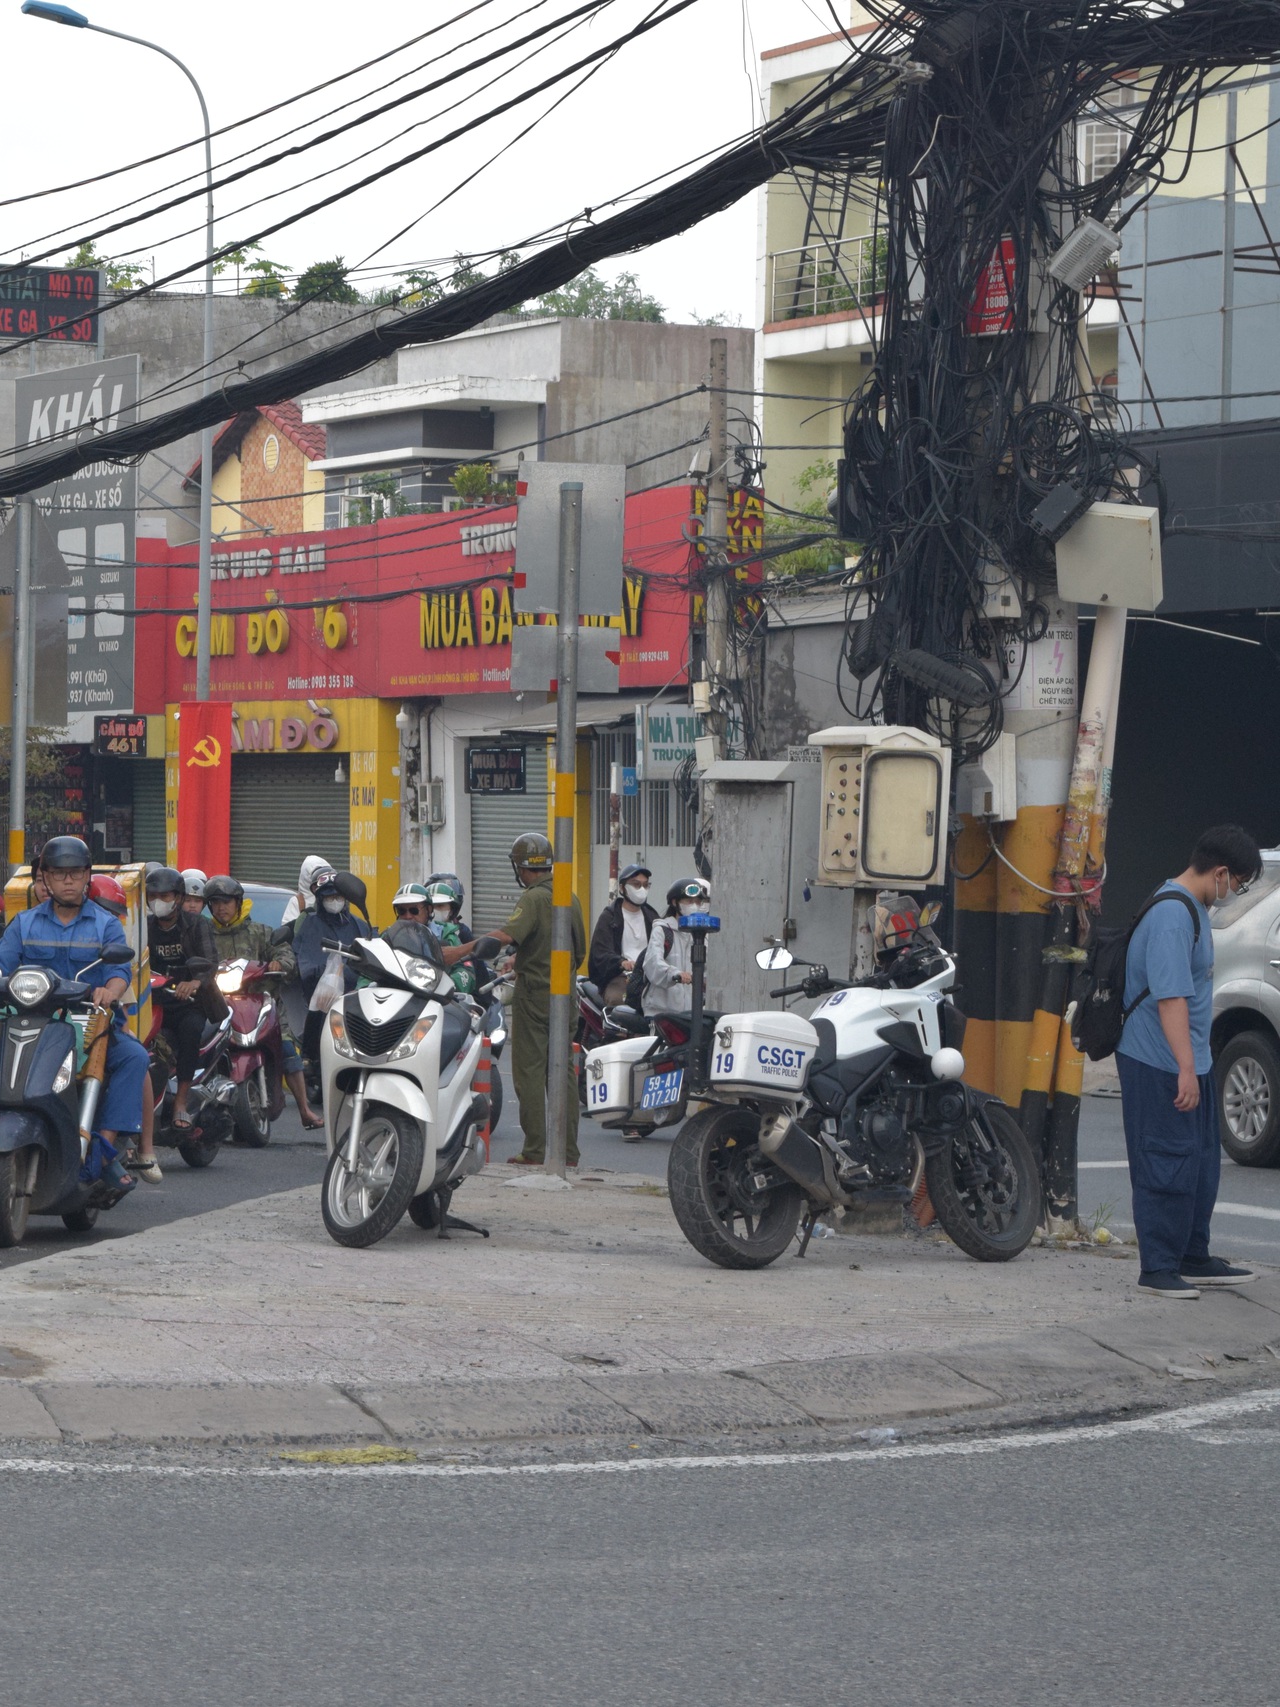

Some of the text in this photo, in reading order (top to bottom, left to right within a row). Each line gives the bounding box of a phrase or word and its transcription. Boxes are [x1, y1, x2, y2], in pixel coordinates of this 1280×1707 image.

[18, 309, 38, 333] GA
[48, 315, 67, 339] XE
[27, 374, 123, 446] KHÁI
[73, 492, 87, 513] GA
[95, 489, 106, 509] XE
[109, 479, 122, 507] SỐ
[280, 543, 326, 575] NAM
[100, 572, 120, 584] SUZUKI
[421, 590, 475, 648] MUA
[84, 669, 108, 687] (Khái)
[329, 675, 341, 688] 355
[84, 689, 114, 706] (Khanh)
[280, 699, 339, 750] ĐỒ
[648, 712, 674, 743] NHÀ
[107, 738, 138, 753] 461
[653, 744, 696, 761] TRƯỜN
[352, 787, 360, 806] XE
[716, 1052, 734, 1074] 19
[757, 1045, 806, 1068] C.S.G.T
[648, 1071, 677, 1092] 59-A1
[761, 1065, 798, 1078] TRAFFIC POLICE
[590, 1082, 608, 1104] 19
[642, 1087, 679, 1107] 017.20
